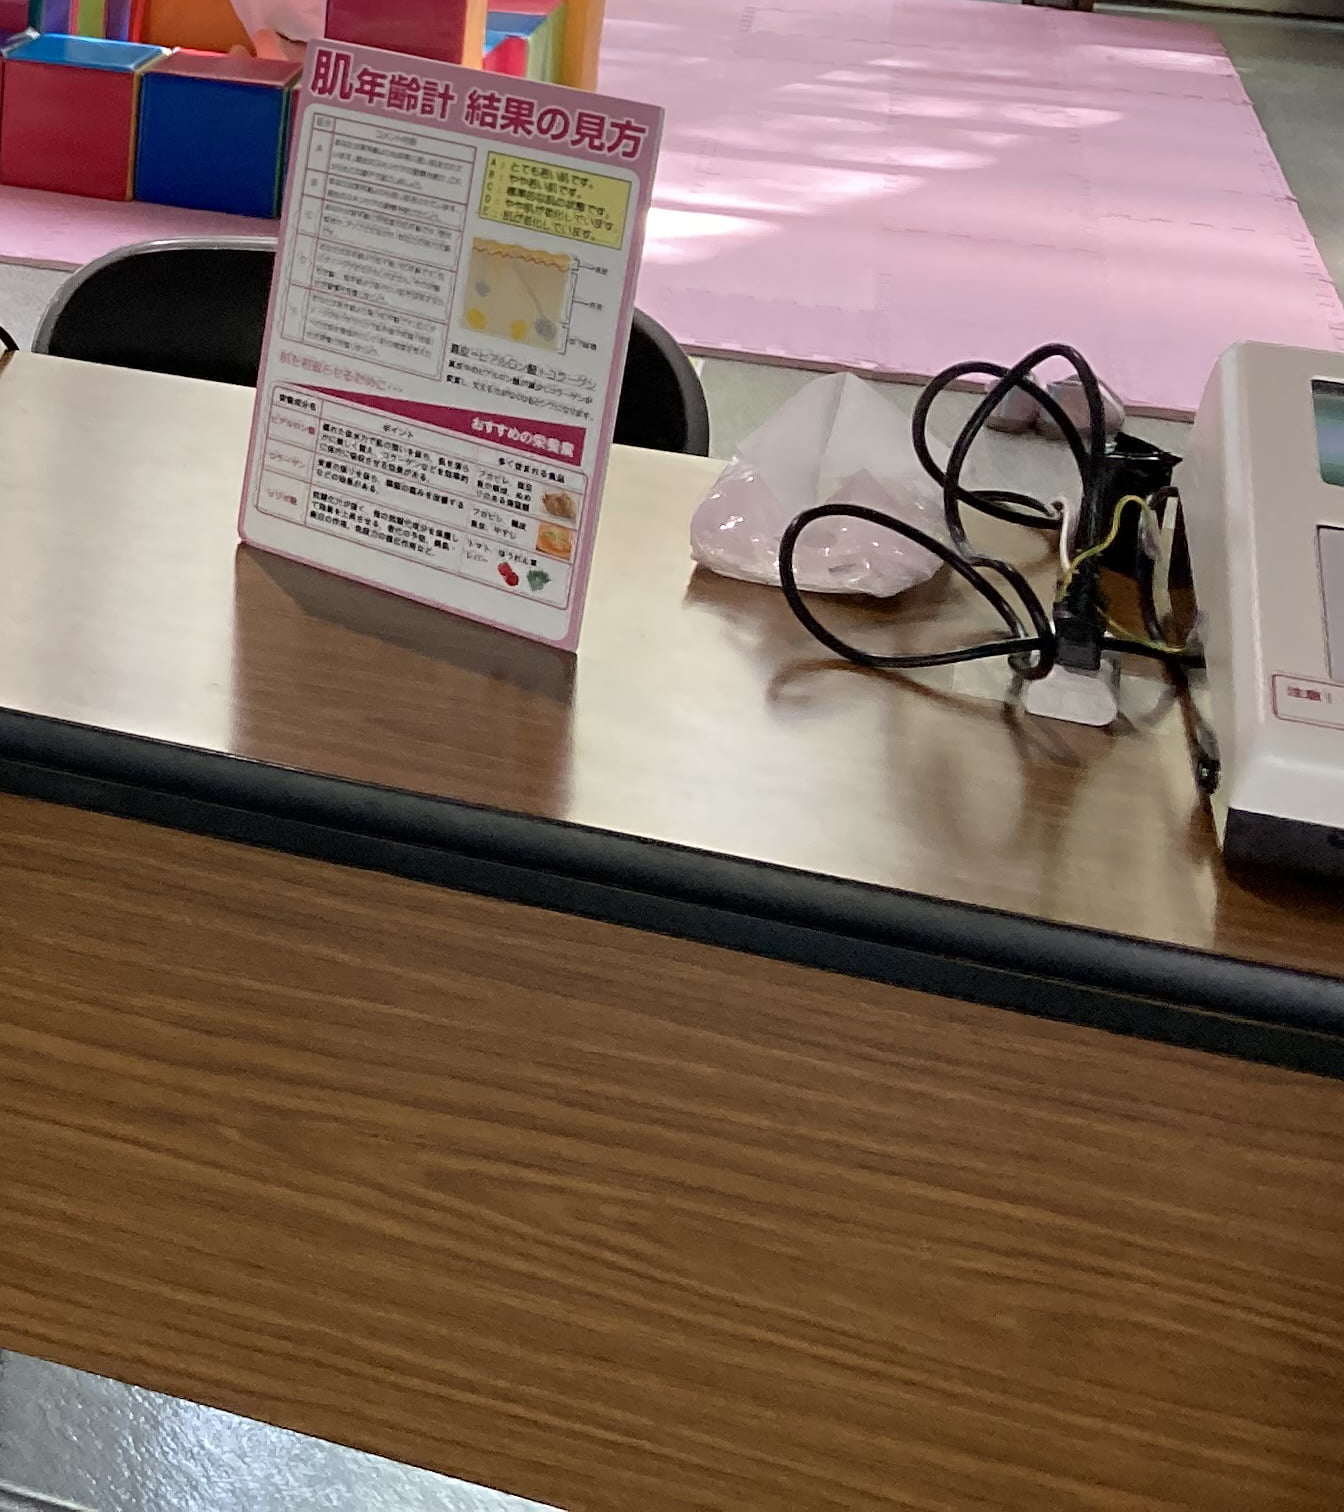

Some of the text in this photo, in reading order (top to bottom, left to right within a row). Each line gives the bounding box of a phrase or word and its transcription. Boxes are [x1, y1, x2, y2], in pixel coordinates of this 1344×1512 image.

[311, 50, 455, 120] 肌年齢計
[466, 89, 648, 159] 結果の見方
[471, 416, 575, 458] おすすめの栄養素
